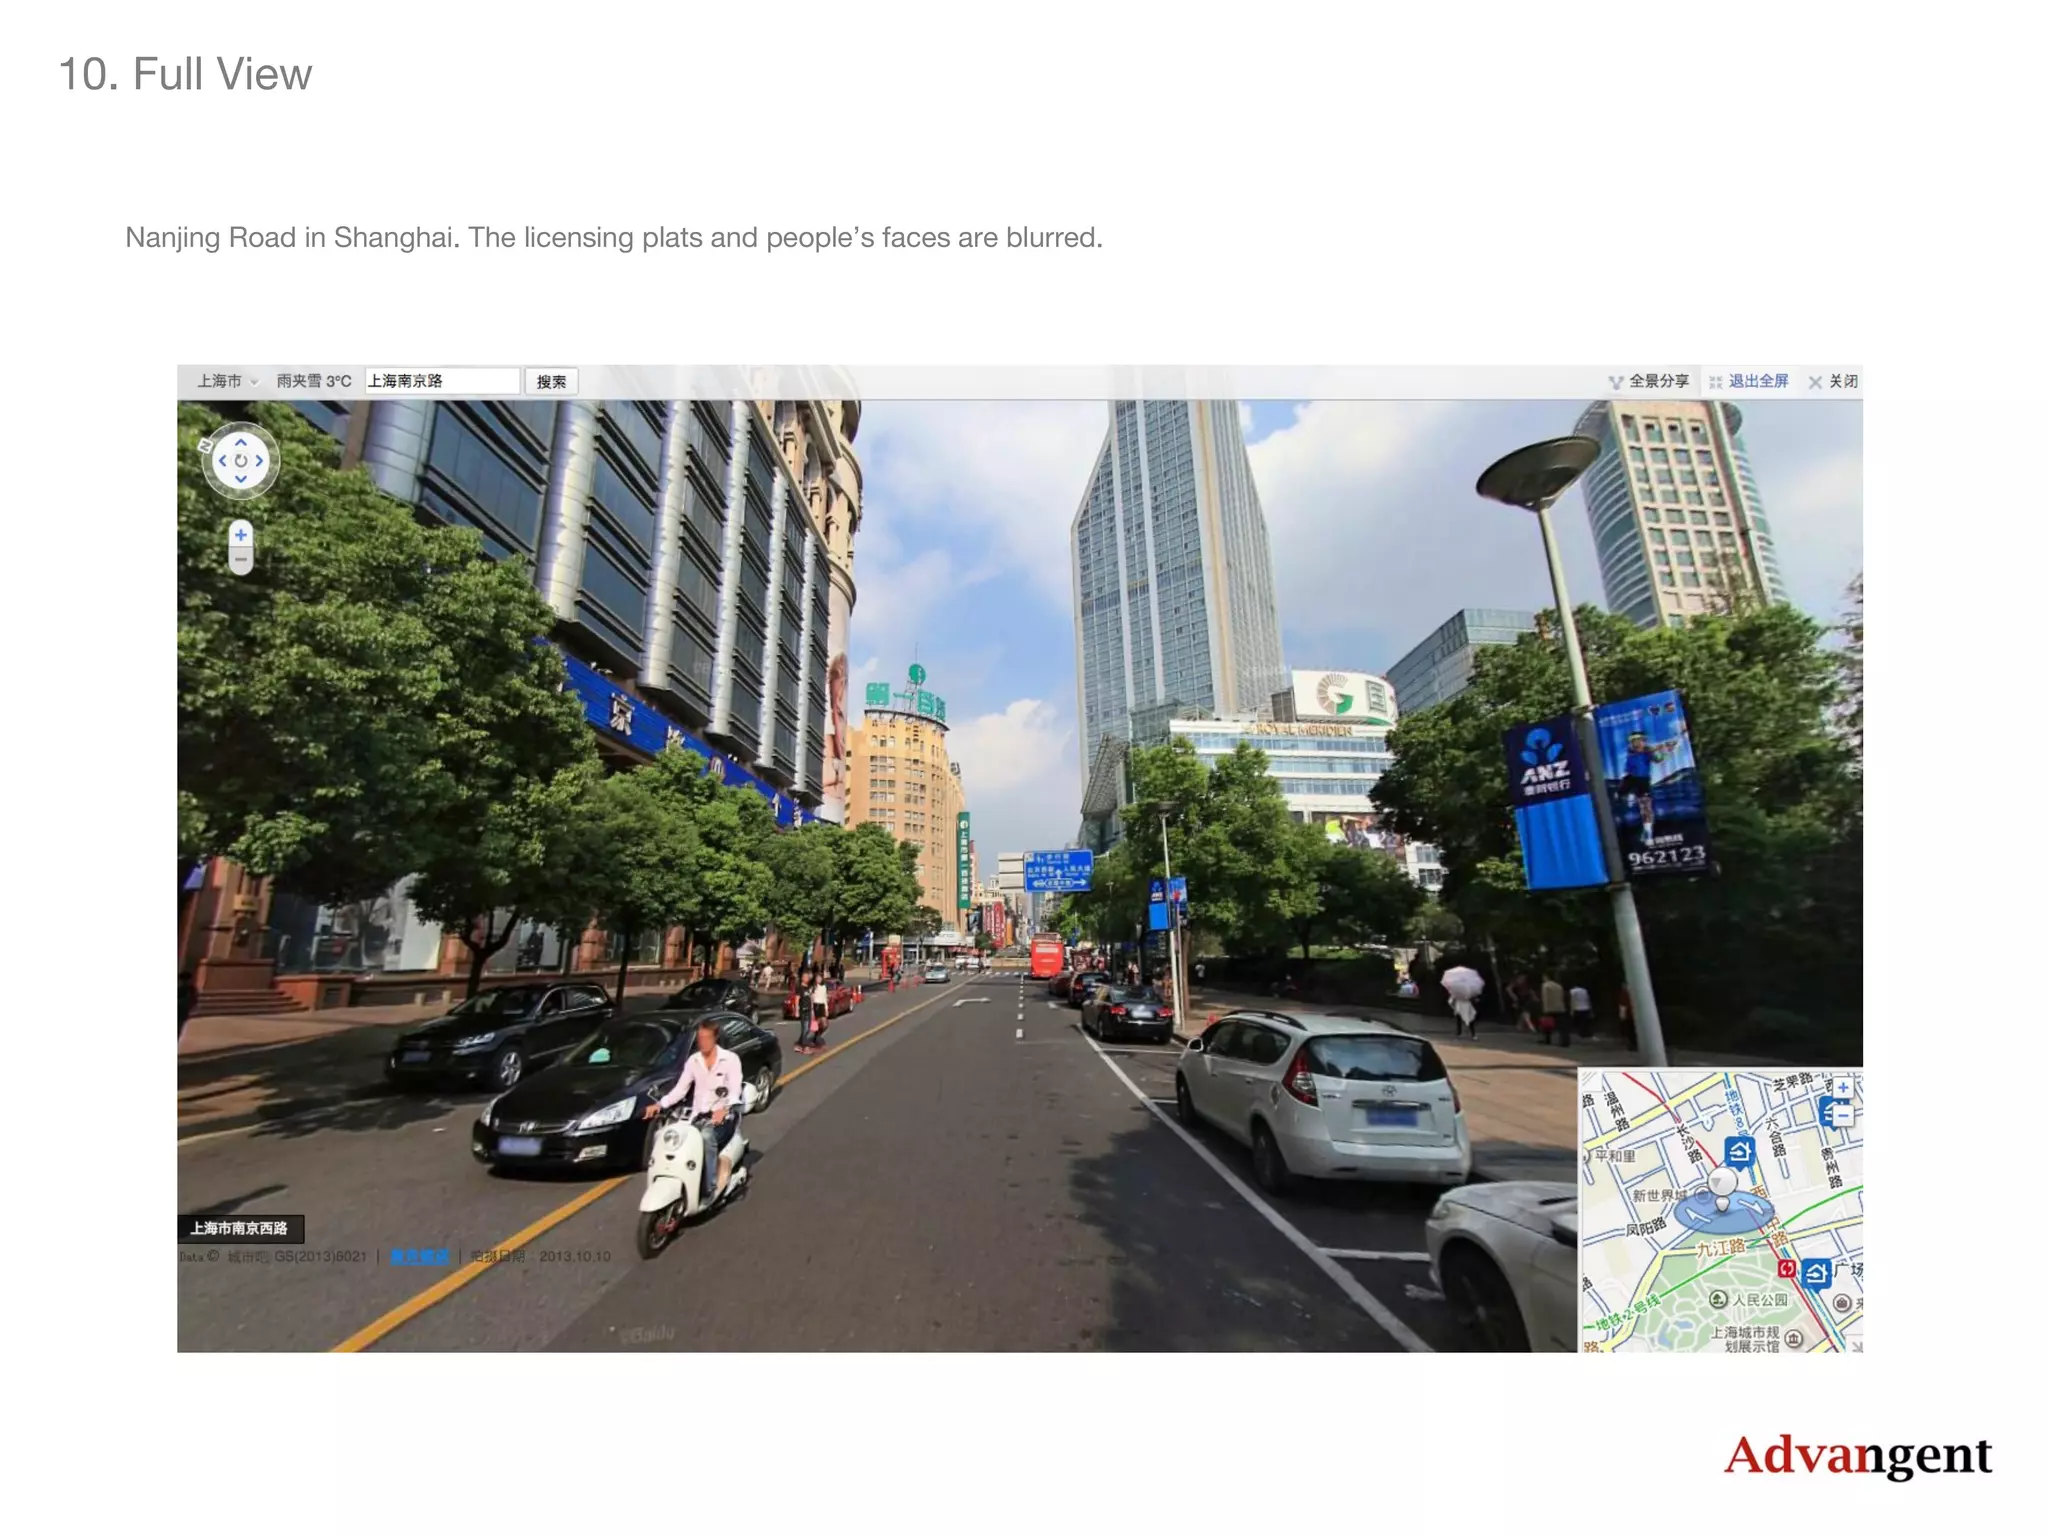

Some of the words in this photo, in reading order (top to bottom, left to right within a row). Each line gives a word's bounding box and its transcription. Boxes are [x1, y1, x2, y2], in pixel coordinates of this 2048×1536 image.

[198, 373, 242, 389] 上海市
[277, 373, 322, 389] 雨夹雪
[367, 373, 443, 389] 上海南京路
[537, 374, 567, 390] 搜索
[1630, 373, 1690, 389] 全景分享
[1729, 373, 1789, 389] 退出全屏
[1830, 373, 1859, 389] 关闭
[1520, 760, 1571, 785] ANZ
[1628, 845, 1706, 866] 962123
[1676, 1124, 1703, 1164] 长沙路
[1766, 1117, 1787, 1158] 六合路
[1595, 1150, 1636, 1163] 平和里
[1633, 1189, 1688, 1203] 新世界城
[190, 1221, 288, 1235] 上海市南京西路
[1626, 1216, 1667, 1237] 凤阳路
[1697, 1238, 1746, 1258] 九江路
[1733, 1293, 1788, 1307] 人民公园
[1711, 1325, 1780, 1339] 上海城市规
[1725, 1340, 1780, 1353] 划展示馆
